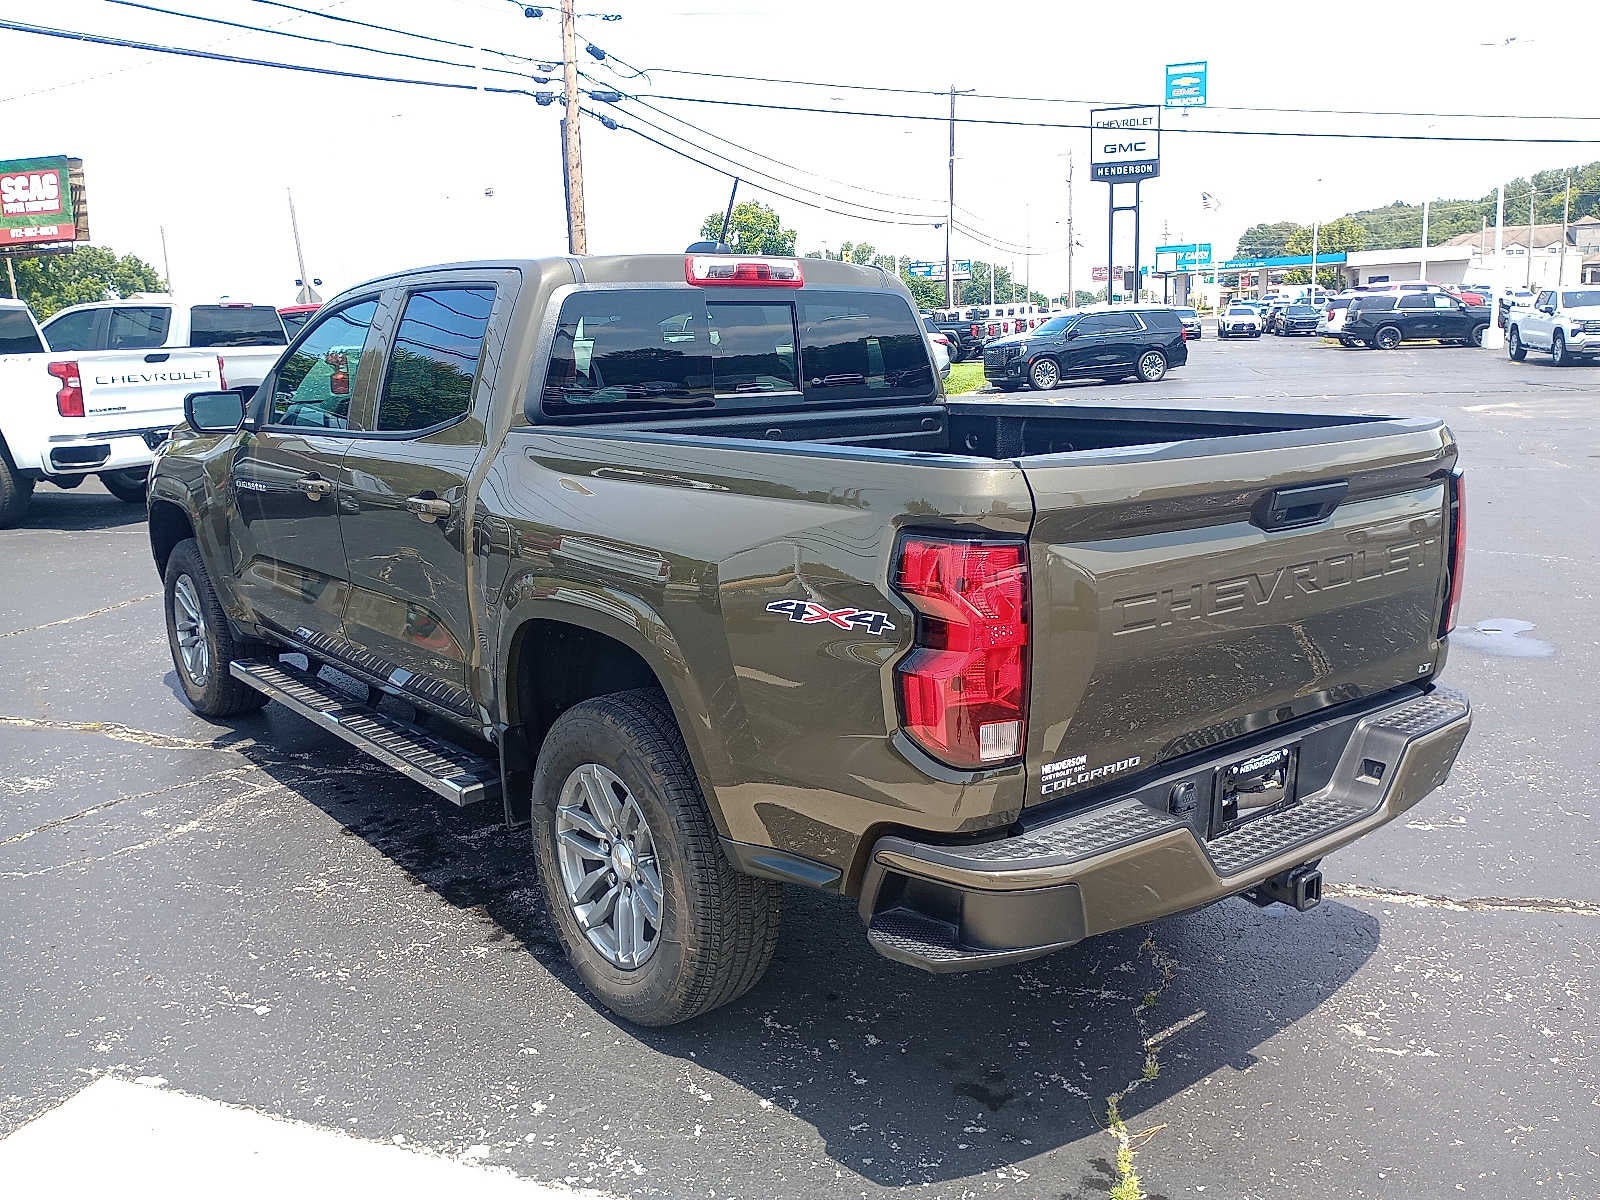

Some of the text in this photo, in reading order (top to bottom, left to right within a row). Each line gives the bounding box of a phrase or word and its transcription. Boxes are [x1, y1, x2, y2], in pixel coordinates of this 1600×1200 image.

[1096, 117, 1153, 128] CHEVROLET
[1103, 141, 1146, 154] GMC
[1097, 164, 1153, 176] HENDERSON
[0, 173, 59, 203] SCAG
[95, 370, 213, 385] CHEVROLET
[1112, 539, 1436, 636] CHEVROLET
[1418, 662, 1432, 674] LT
[1041, 754, 1087, 776] HENDERSON
[1239, 752, 1282, 775] HENDERSON
[1041, 756, 1141, 795] COLORADO
